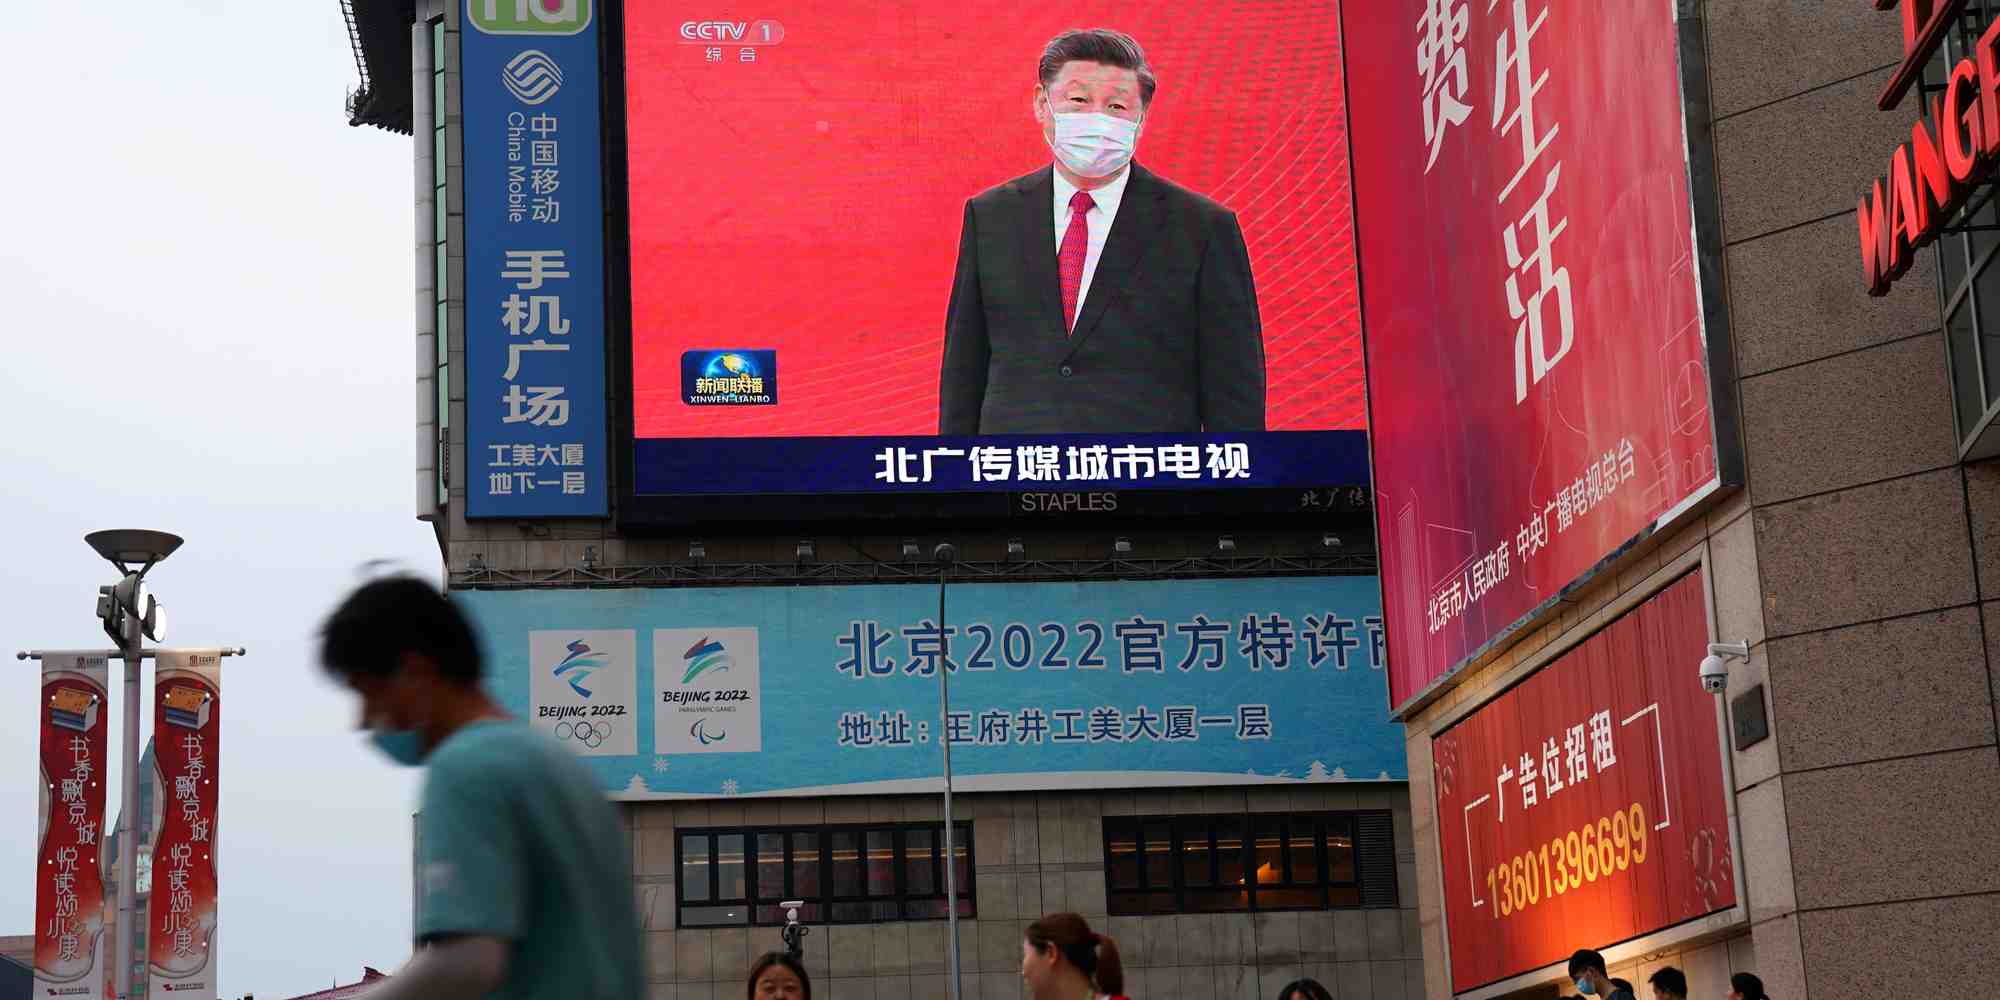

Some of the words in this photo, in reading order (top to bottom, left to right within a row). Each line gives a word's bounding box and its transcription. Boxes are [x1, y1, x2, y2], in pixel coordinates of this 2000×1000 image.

[680, 21, 747, 41] CCTV
[762, 23, 770, 41] 1
[507, 111, 526, 162] China
[507, 166, 526, 223] Mobile
[530, 112, 560, 224] 中国移动
[501, 250, 570, 426] 手机广场
[690, 395, 729, 403] XINWEN
[735, 395, 770, 403] LIANBO
[695, 377, 763, 394] 新闻联播
[488, 444, 585, 466] 工美大厦
[874, 442, 1251, 483] 北广传媒城市电视
[488, 471, 585, 495] 地下一层
[1021, 492, 1118, 511] STAPLES
[1427, 540, 1510, 634] 北京市人民政府
[1516, 438, 1635, 563] 中央广播电视总台
[538, 706, 587, 720] BEIJING
[591, 705, 627, 716] 2022
[662, 691, 711, 705] BEIJING
[714, 690, 751, 701] 2022
[61, 736, 97, 845] 书香飘京城
[175, 733, 209, 841] 书香飘京城
[1497, 709, 1616, 823] 广告位招租
[1487, 803, 1647, 919] 13601396699
[47, 847, 81, 961] 悦读颂小康
[162, 843, 193, 957] 悦读颂小康
